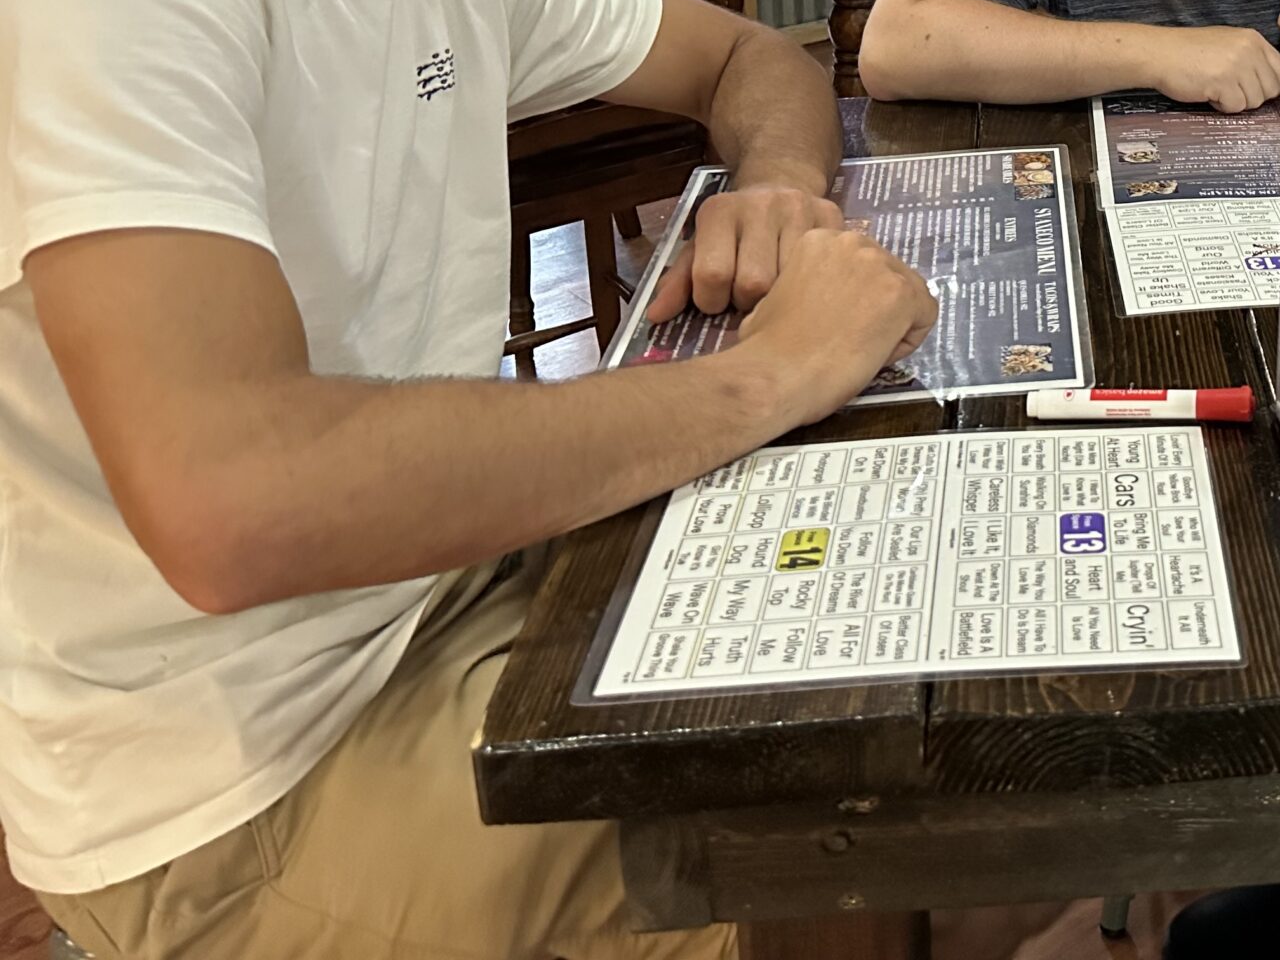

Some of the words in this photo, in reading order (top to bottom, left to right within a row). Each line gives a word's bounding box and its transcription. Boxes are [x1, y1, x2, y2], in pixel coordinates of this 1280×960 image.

[1004, 217, 1017, 243] ENTREES
[1033, 207, 1054, 246] SVAXECO
[1182, 235, 1230, 243] Diamonds
[1194, 245, 1224, 253] Song
[1036, 246, 1057, 277] MENU
[1248, 258, 1274, 270] 13
[1044, 281, 1058, 303] TACOS
[1146, 292, 1183, 300] Times
[1148, 282, 1186, 291] Shake
[1210, 294, 1243, 302] Shake
[1150, 298, 1183, 306] Good
[1047, 309, 1060, 333] WRAPS
[1126, 440, 1140, 464] Young
[813, 452, 831, 484] Photograph
[964, 479, 981, 513] Whisper
[987, 478, 1003, 512] Careless
[1114, 473, 1139, 507] Cars
[714, 503, 731, 525] Prove
[748, 494, 772, 529] Lollipop
[855, 486, 870, 520] Ghostbusters
[839, 528, 852, 541] You
[1114, 518, 1127, 528] To
[1133, 513, 1148, 534] Bring
[857, 532, 872, 557] Follow
[1025, 517, 1039, 554] Diamonds
[1113, 529, 1129, 545] Life
[1137, 536, 1150, 550] Me
[726, 545, 748, 564] Dog
[751, 538, 774, 568] Hound
[835, 543, 849, 565] Down
[1065, 559, 1079, 576] and
[1088, 565, 1102, 591] Heart
[1169, 555, 1185, 595] Heartache
[726, 580, 751, 595] My
[851, 572, 866, 587] The
[1065, 578, 1081, 600] Soul
[659, 592, 681, 618] Wave
[767, 587, 789, 605] Top
[792, 580, 815, 610] Rocky
[847, 588, 863, 609] River
[721, 598, 746, 621] Way
[843, 624, 860, 638] All
[897, 615, 911, 638] Better
[957, 612, 973, 656] Battlefield
[1122, 604, 1155, 648] Cryin'
[1193, 601, 1211, 645] Underneath
[697, 637, 720, 667] Hurts
[726, 636, 748, 663] Truth
[757, 639, 776, 656] Me
[782, 628, 803, 663] Follow
[814, 630, 832, 656] Love
[840, 641, 857, 659] For
[894, 640, 907, 660] Class
